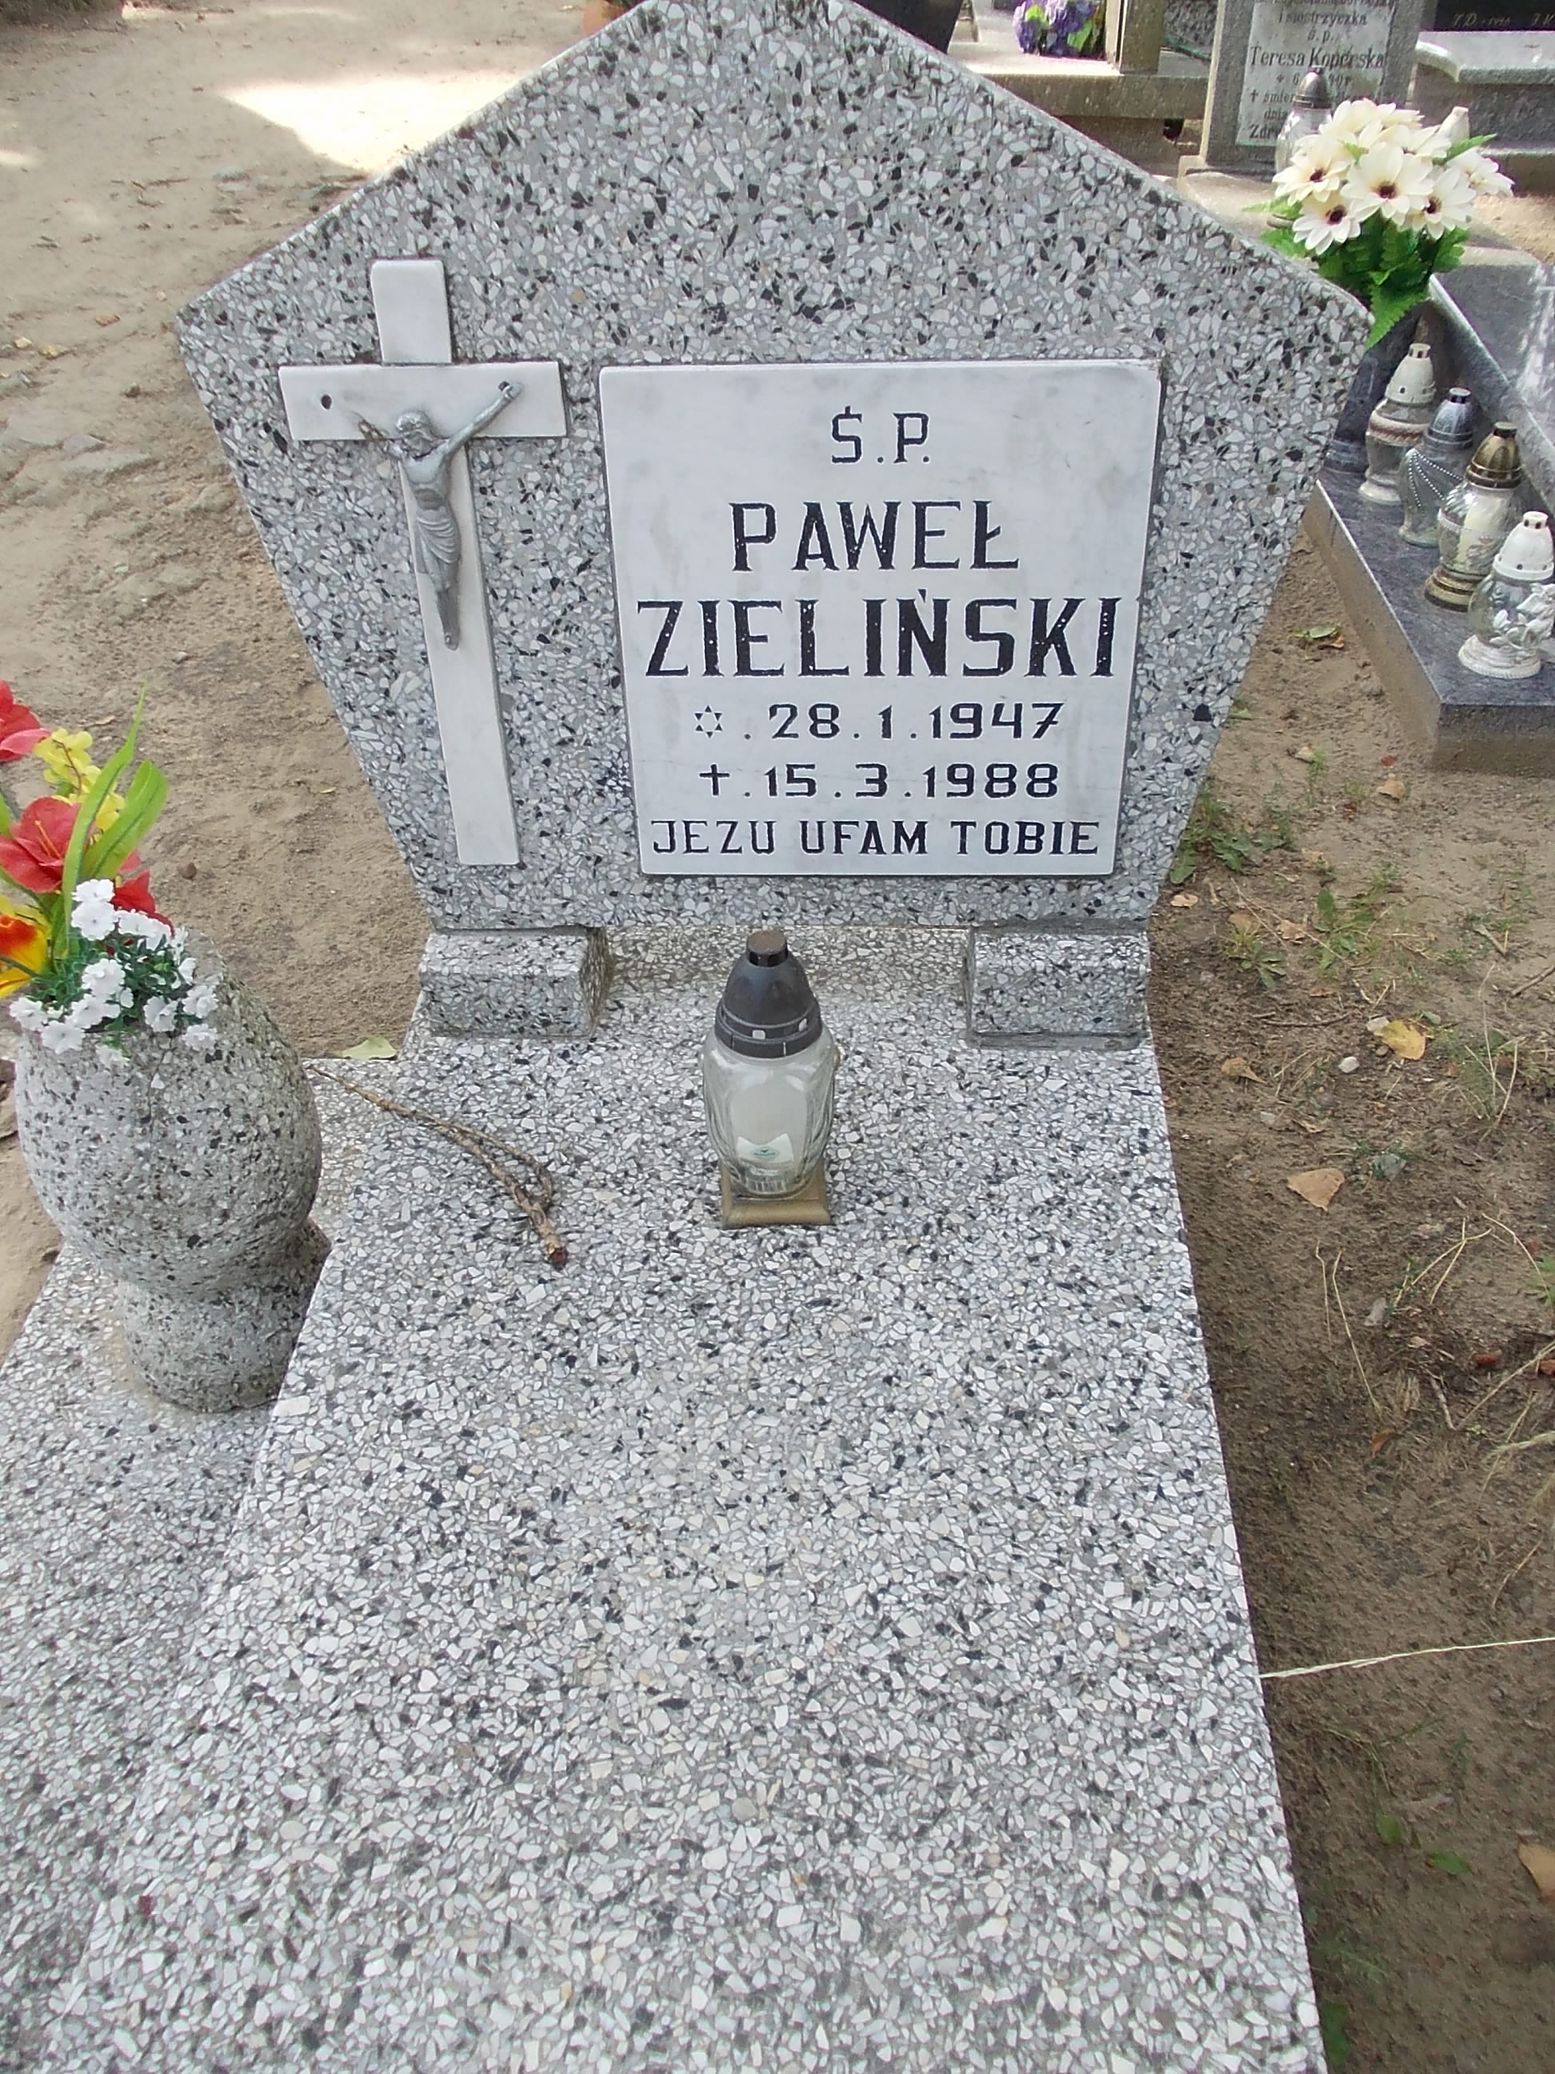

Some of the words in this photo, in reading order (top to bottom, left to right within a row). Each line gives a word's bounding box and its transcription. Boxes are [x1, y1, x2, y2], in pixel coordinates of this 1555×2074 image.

[1250, 46, 1306, 66] Teresa
[728, 500, 1020, 572] PAWEŁ
[637, 588, 1123, 678] ZIELIŃSKI
[651, 820, 776, 855] JEZU
[800, 820, 928, 856] UFAM
[950, 820, 1100, 856] TOBIE
